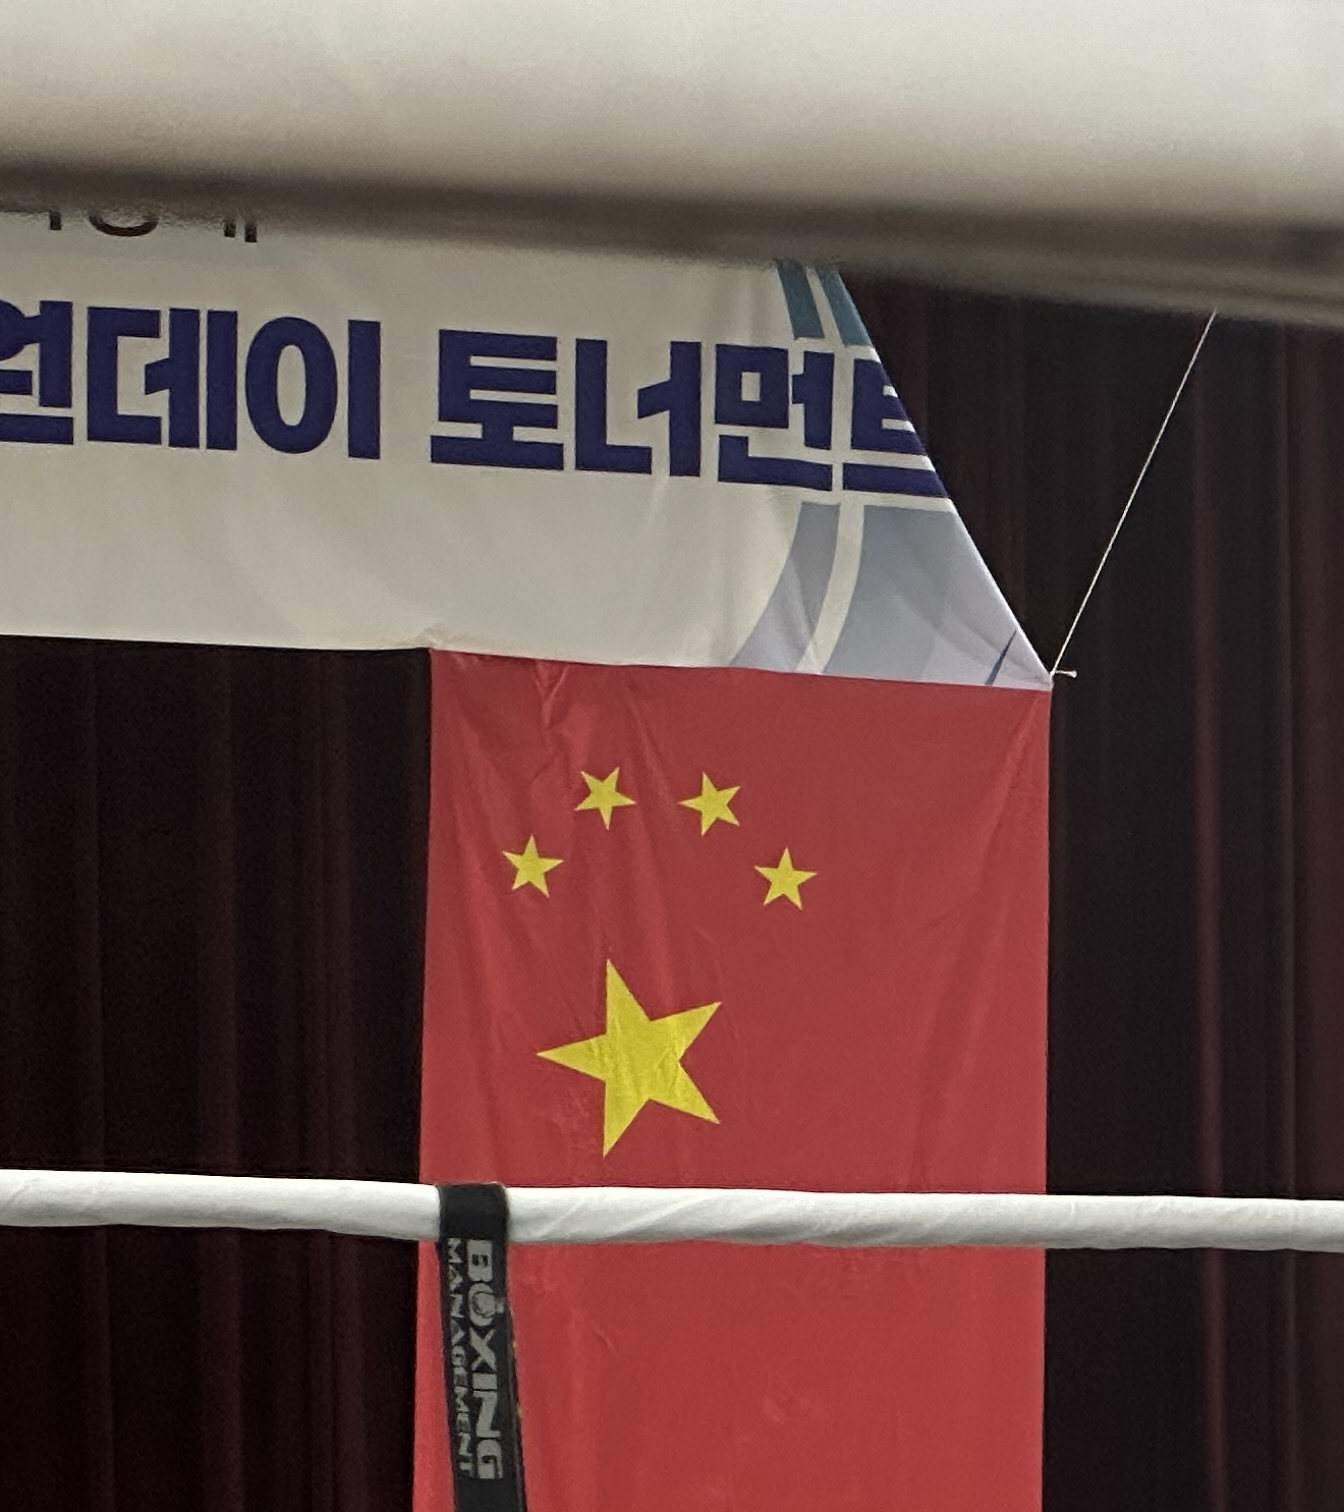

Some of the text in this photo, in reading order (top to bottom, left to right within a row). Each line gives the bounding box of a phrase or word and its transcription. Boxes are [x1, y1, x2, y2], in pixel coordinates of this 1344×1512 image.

[430, 329, 949, 498] 토너먼트
[447, 1237, 473, 1478] MANAGEMENT
[466, 1239, 505, 1480] BOXING
